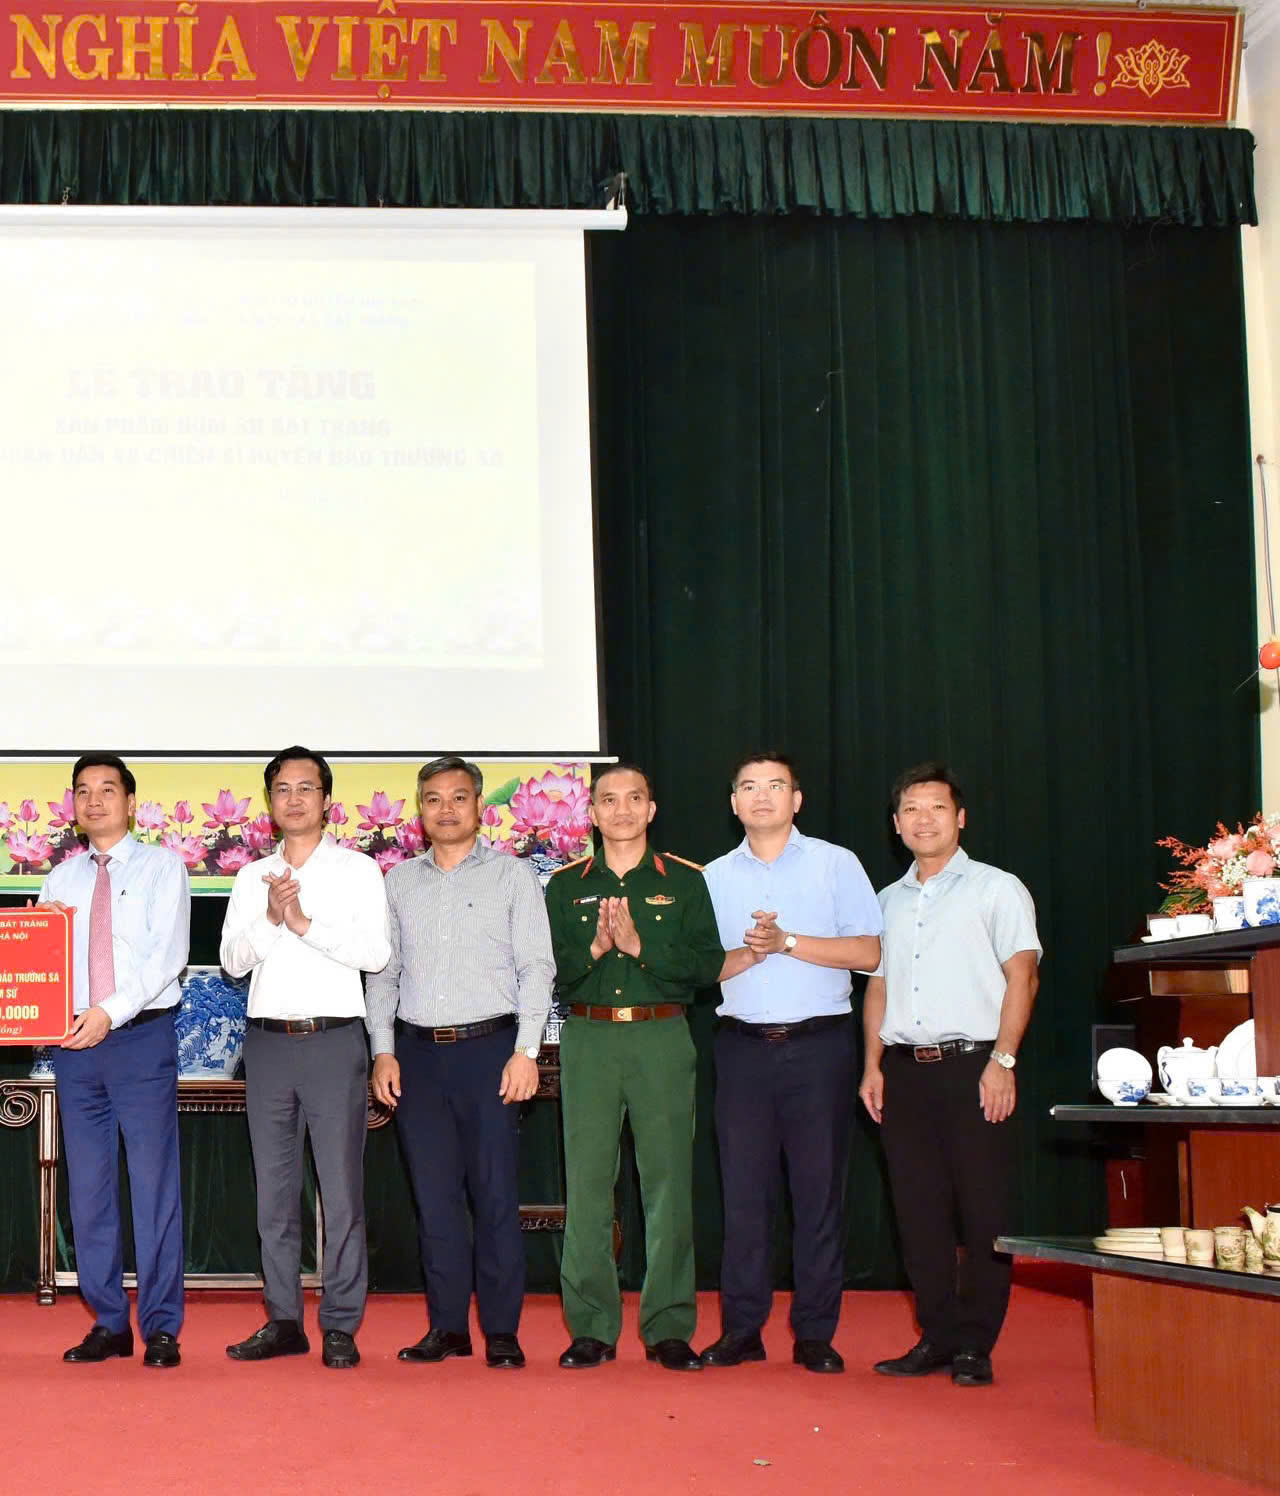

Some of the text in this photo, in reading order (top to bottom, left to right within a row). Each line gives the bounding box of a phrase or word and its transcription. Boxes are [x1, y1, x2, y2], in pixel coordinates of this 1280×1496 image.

[10, 2, 257, 81] NGHĨA
[276, 0, 457, 99] VIỆT
[479, 18, 656, 85] NAM
[676, 10, 896, 91] MUÔN
[48, 971, 60, 983] SA
